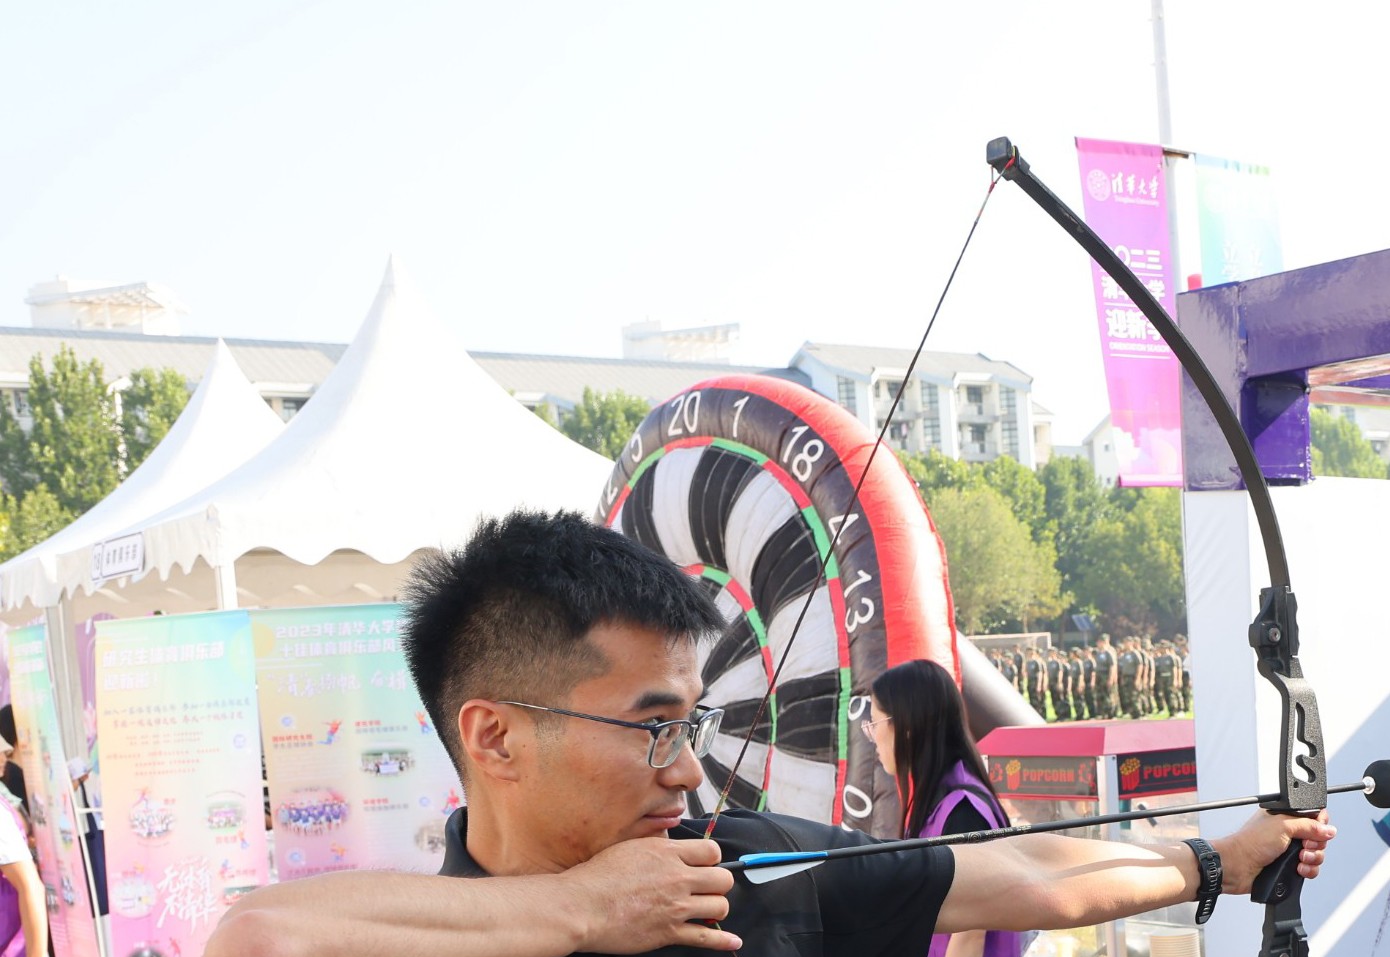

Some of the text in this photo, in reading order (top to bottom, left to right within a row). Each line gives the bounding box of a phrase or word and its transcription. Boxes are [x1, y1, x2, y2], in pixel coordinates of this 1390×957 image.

[668, 390, 701, 437] 20
[731, 395, 751, 438] 1
[782, 425, 826, 484] 18
[827, 511, 860, 546] 4
[843, 568, 875, 634] 13
[1022, 768, 1075, 783] POPCORN
